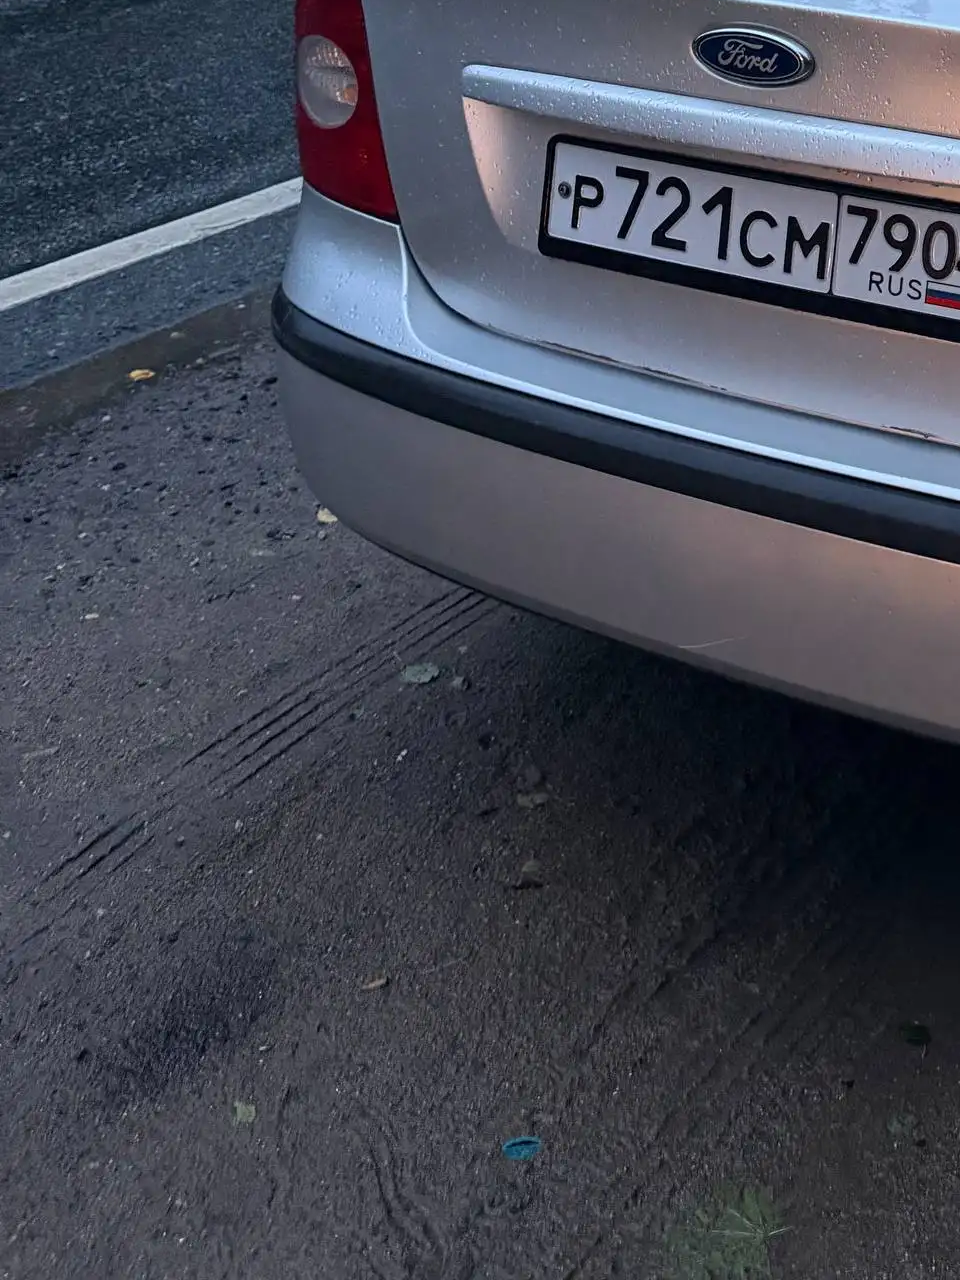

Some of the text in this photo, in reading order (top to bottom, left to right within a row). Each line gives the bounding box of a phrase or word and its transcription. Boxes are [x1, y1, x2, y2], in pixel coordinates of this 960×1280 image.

[717, 38, 779, 73] Ford
[847, 204, 957, 280] 790
[868, 271, 922, 300] RUS
